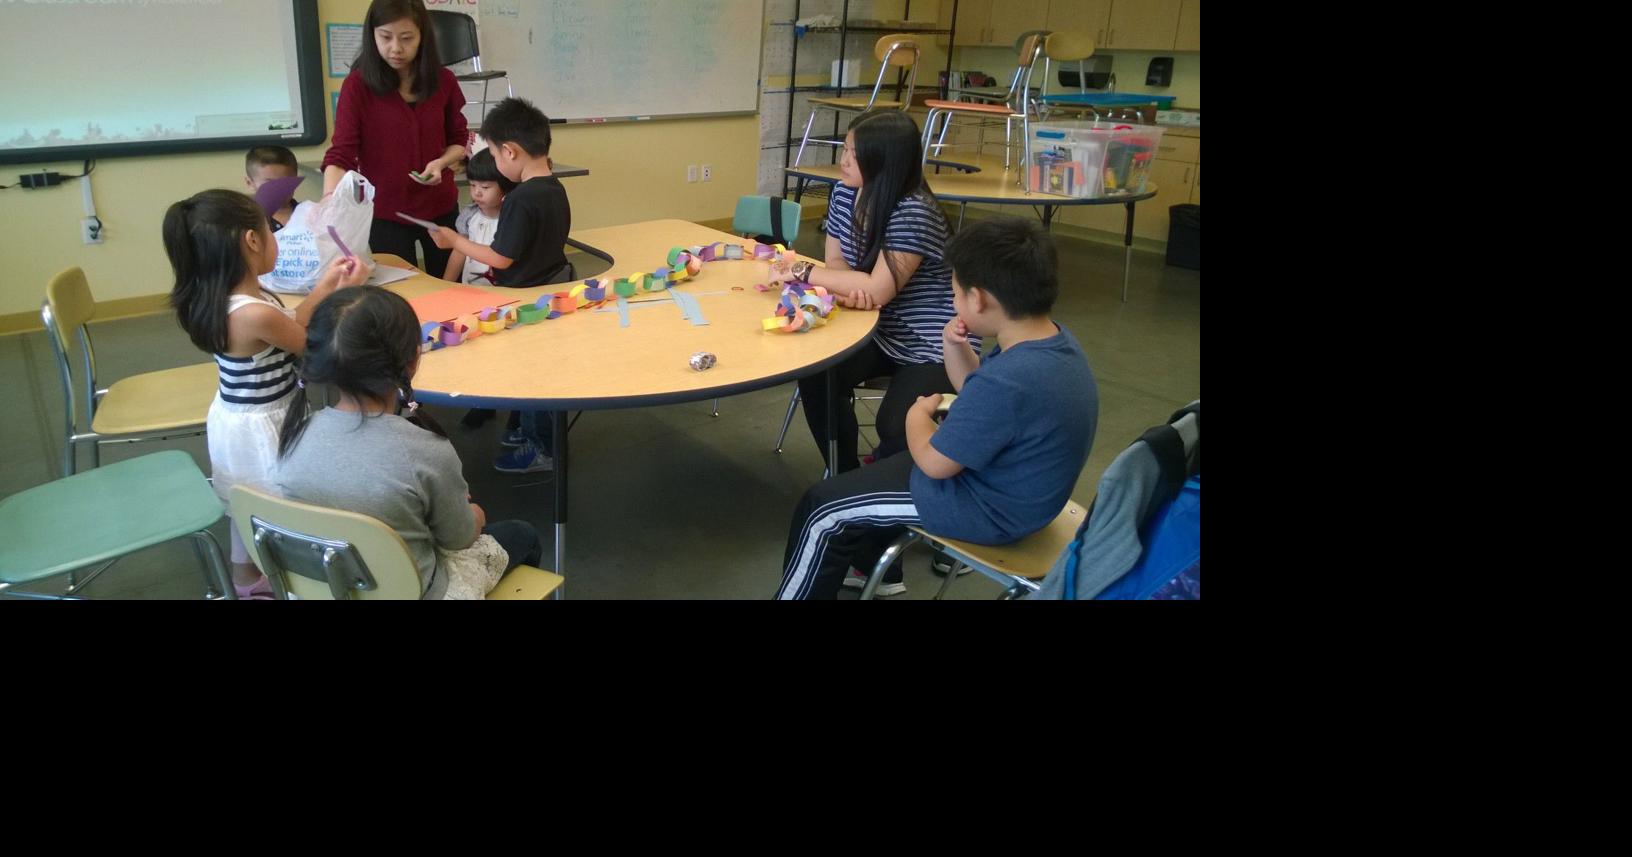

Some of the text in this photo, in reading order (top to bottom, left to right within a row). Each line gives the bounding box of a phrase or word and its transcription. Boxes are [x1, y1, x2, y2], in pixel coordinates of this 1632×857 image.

[283, 257, 303, 268] pick
[305, 259, 320, 270] up
[280, 270, 305, 278] store
